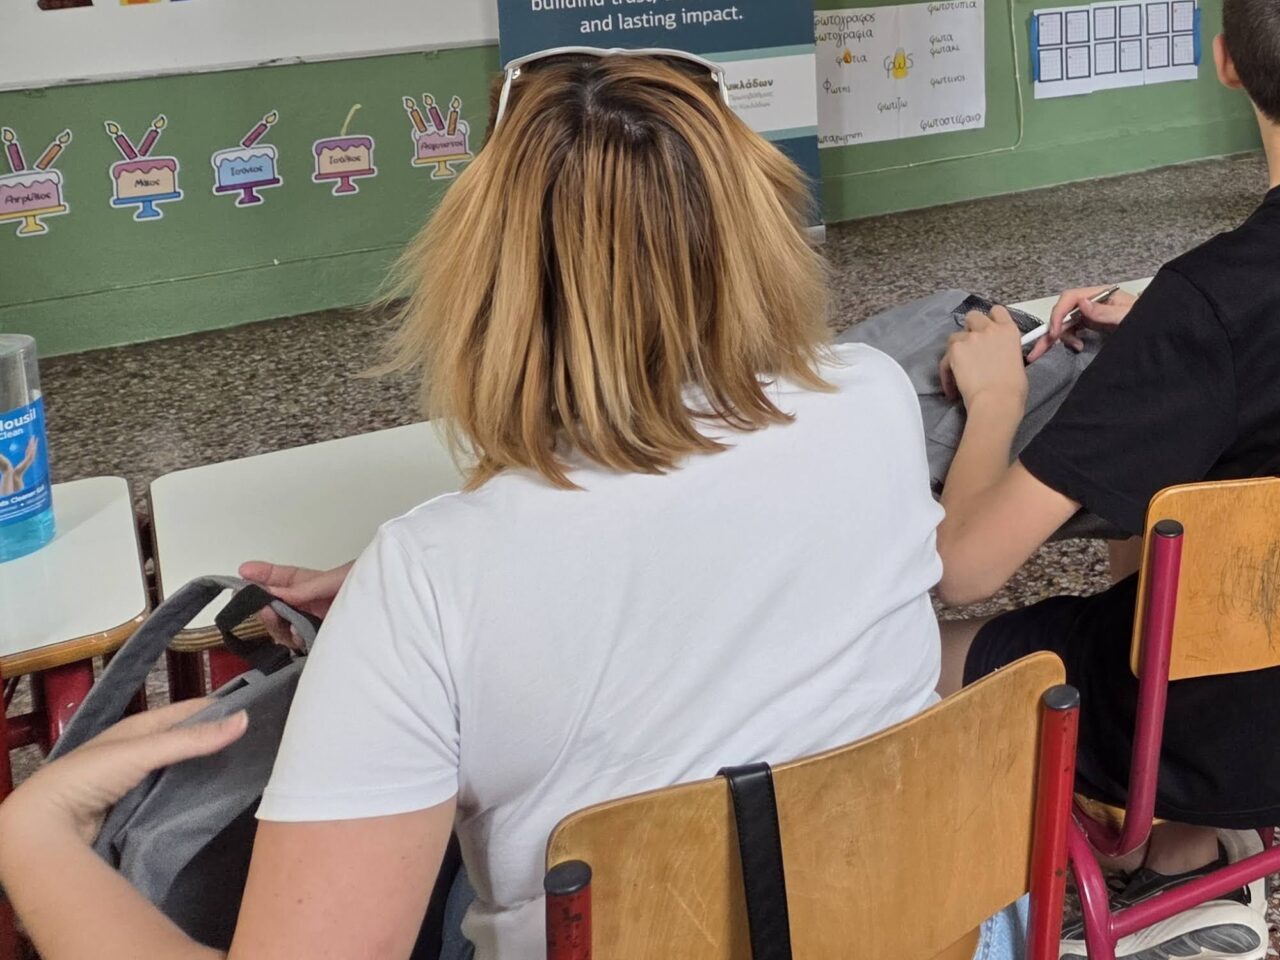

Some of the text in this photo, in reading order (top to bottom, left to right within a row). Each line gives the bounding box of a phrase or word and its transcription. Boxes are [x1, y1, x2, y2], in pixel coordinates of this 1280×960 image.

[580, 5, 744, 34] and lasting impact.
